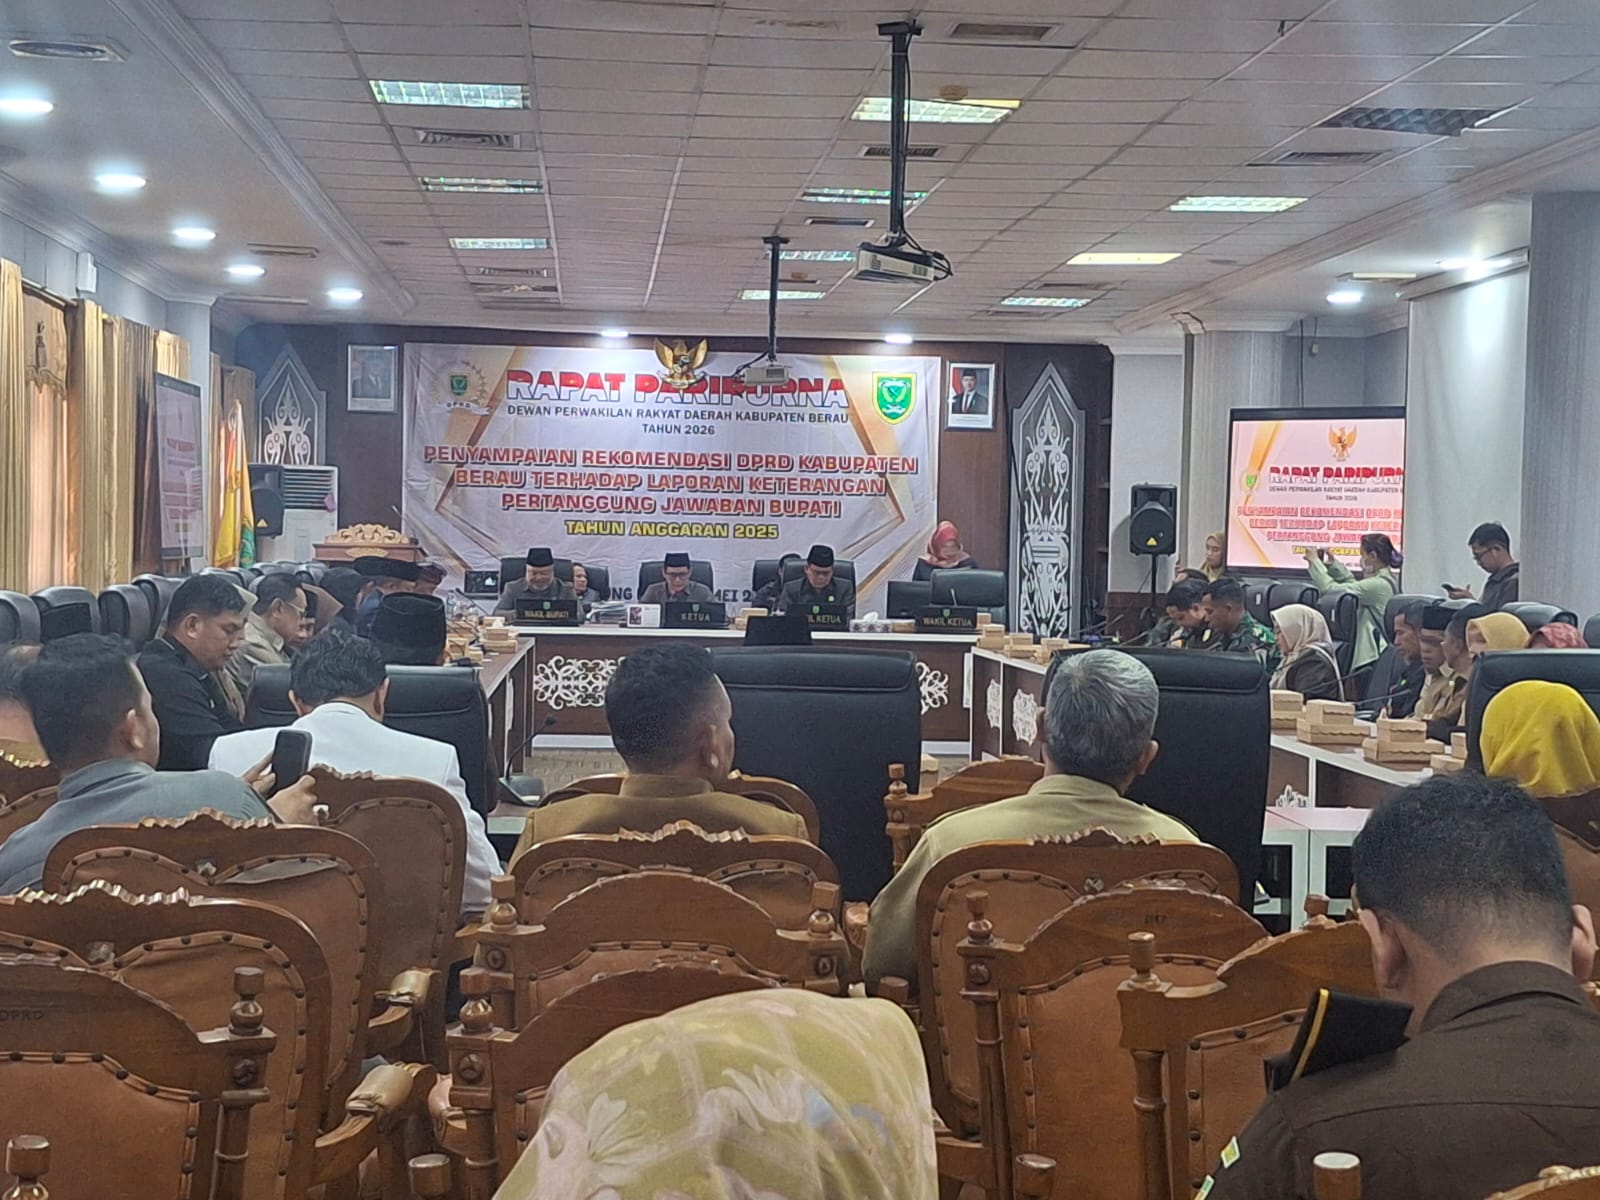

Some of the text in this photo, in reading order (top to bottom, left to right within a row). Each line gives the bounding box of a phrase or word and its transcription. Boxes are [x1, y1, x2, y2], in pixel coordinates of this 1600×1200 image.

[506, 370, 849, 409] RAPAT PARIPURNA
[508, 405, 849, 424] DEWAN PERWAKILAN RAKYAT DAERAH KABUPATEN BERAU
[643, 423, 715, 435] TAHUN 2026
[424, 446, 918, 475] PENYAMPAIAN REKOMENDASI DPRD KABUPATEN
[455, 470, 887, 496] BERAU TERHADAP LAPORAN KETERANGAN
[502, 493, 842, 518] PERTANGGUNG JAWABAN BUPATI
[564, 521, 779, 539] TAHUN ANGGARAN 2025
[681, 612, 711, 622] KETUA
[816, 615, 841, 624] KETUA
[923, 617, 973, 627] WAKIL KETUA
